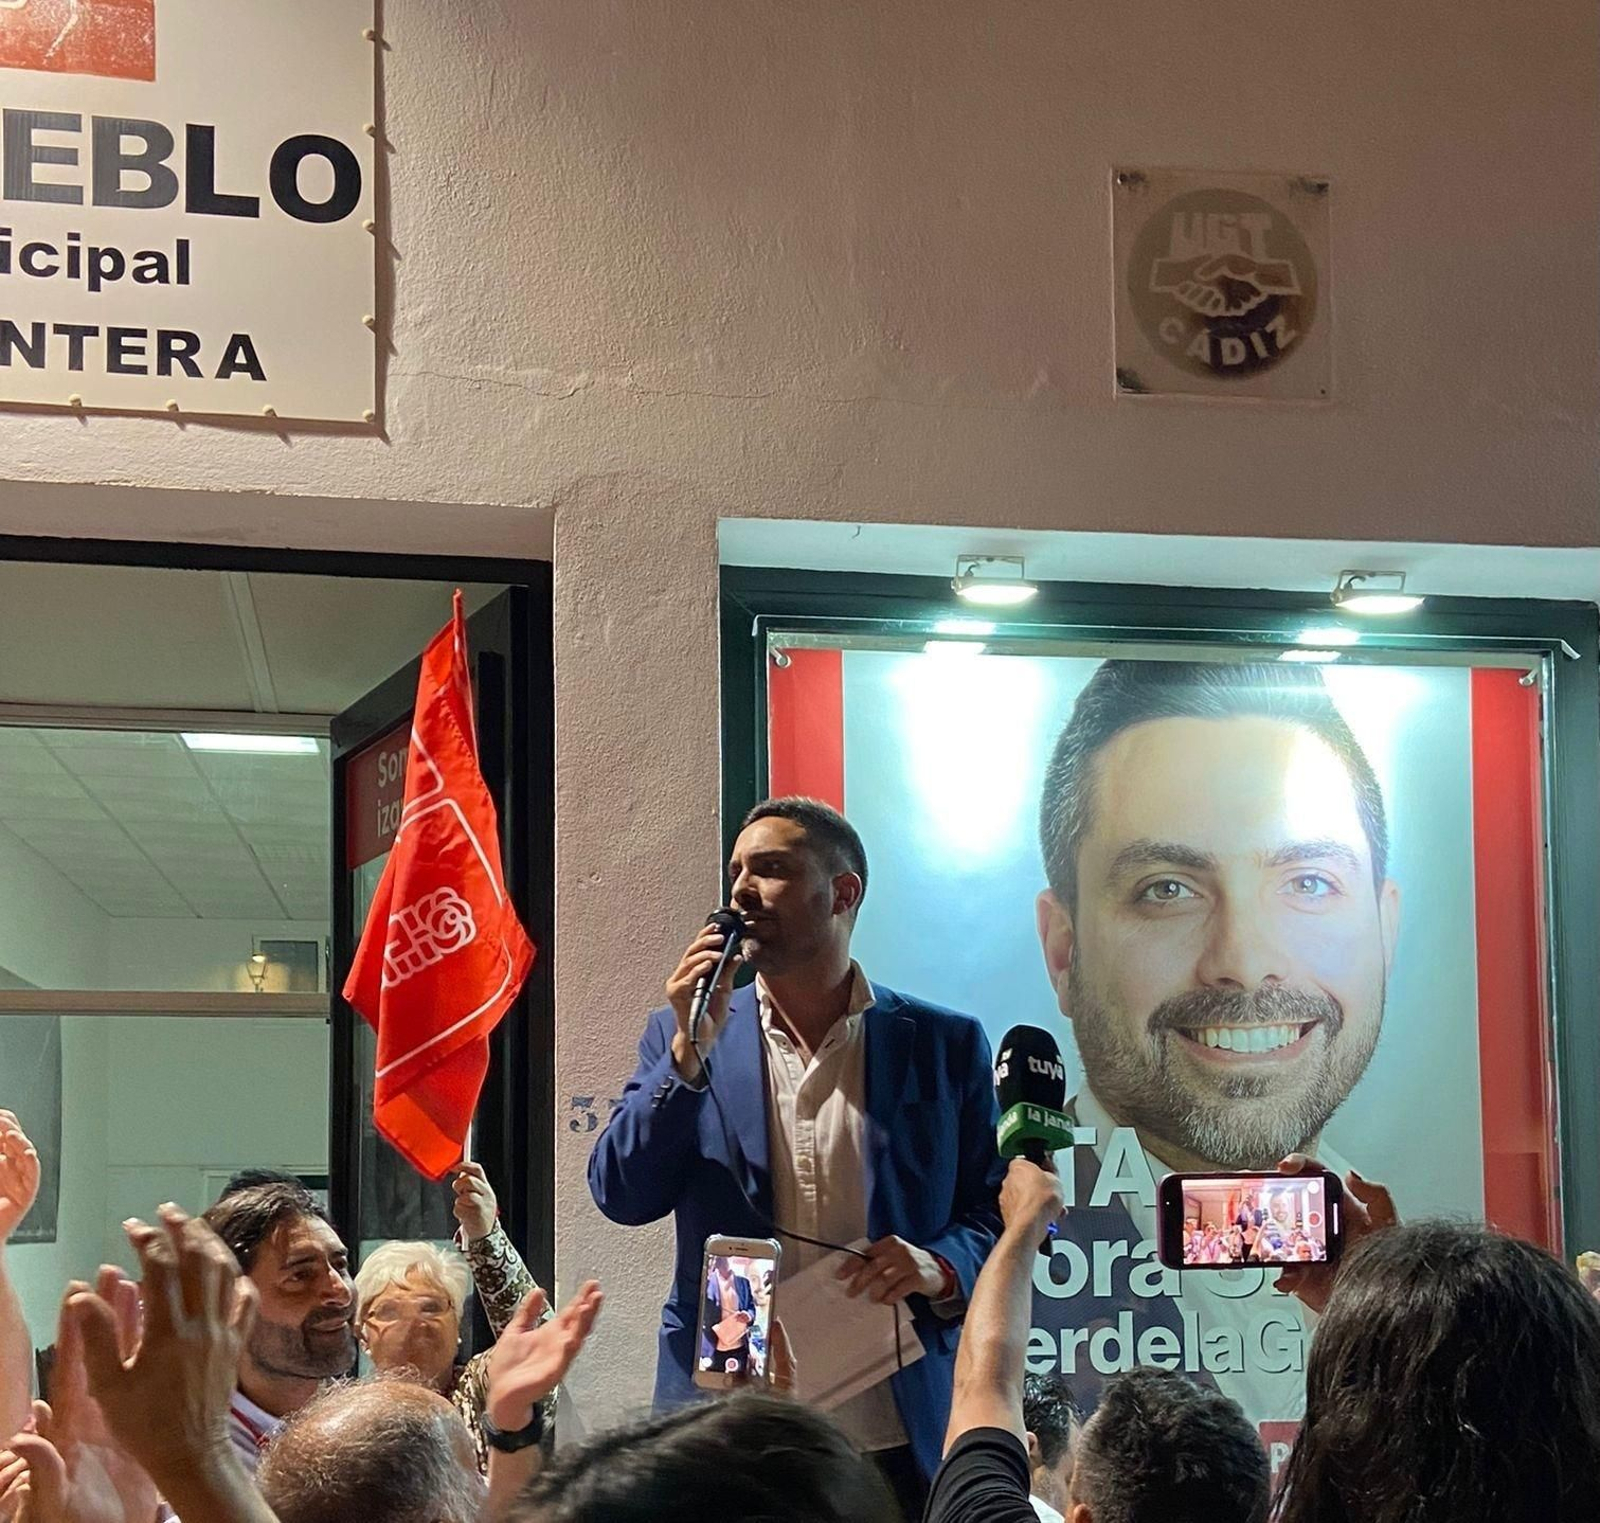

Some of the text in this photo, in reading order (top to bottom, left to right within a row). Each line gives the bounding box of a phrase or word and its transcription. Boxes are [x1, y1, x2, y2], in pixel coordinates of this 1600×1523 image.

[2, 108, 362, 223] EBLO
[1170, 212, 1273, 257] UGT
[0, 320, 267, 381] NTERA
